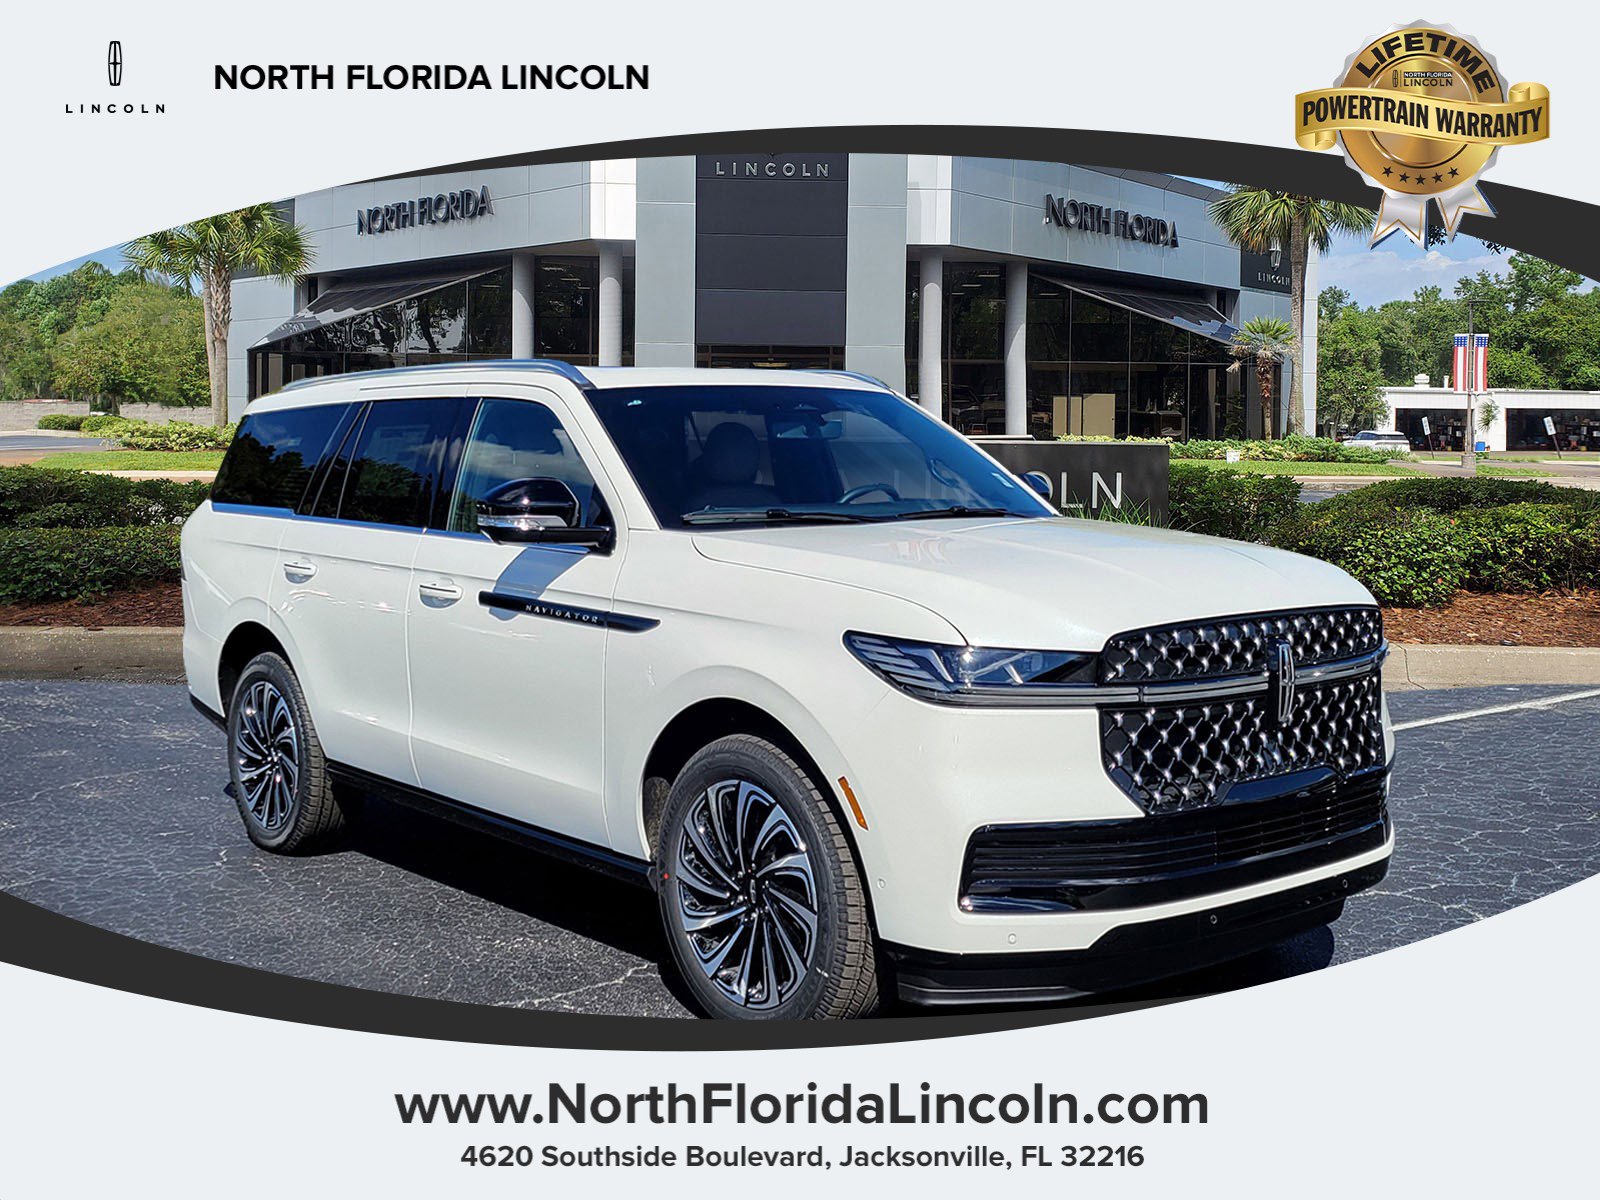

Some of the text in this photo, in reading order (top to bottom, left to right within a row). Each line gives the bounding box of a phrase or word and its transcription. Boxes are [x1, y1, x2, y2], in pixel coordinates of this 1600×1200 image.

[715, 161, 829, 177] LINCOLN
[357, 184, 495, 236] NORTH FLORIDA
[1045, 193, 1180, 248] NORTH FLORIDA
[525, 604, 600, 624] NAVIGATOR
